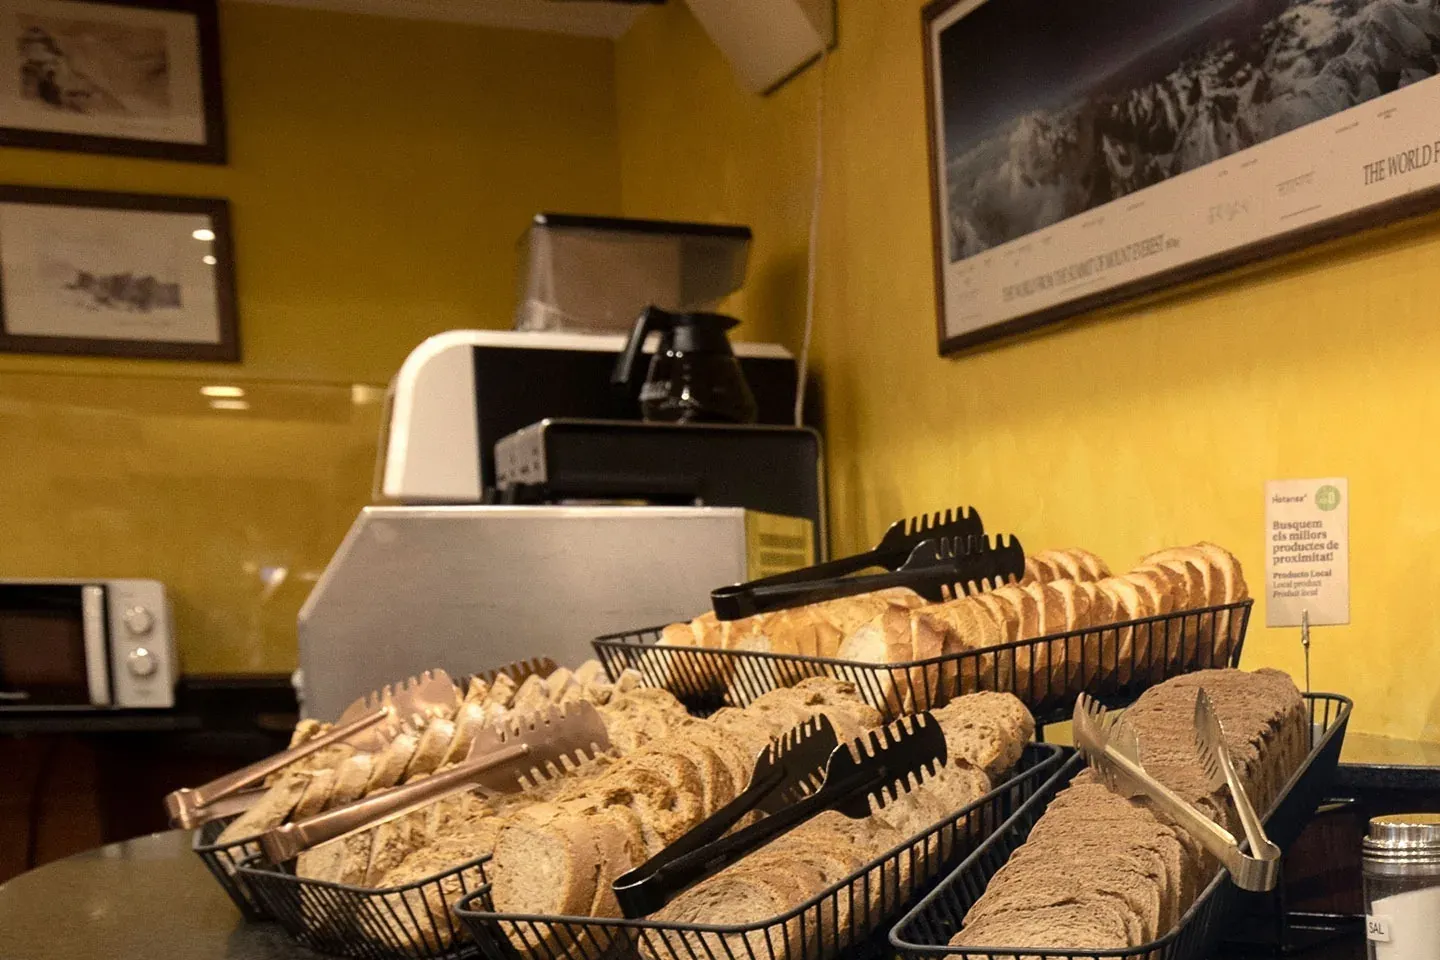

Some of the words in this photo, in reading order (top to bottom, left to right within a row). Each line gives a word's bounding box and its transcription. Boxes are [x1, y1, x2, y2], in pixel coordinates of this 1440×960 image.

[1362, 159, 1385, 186] THE
[1388, 144, 1432, 177] WORLD
[1272, 520, 1322, 531] Busquem
[1272, 531, 1287, 542] els
[1289, 530, 1327, 541] millors
[1272, 541, 1325, 555] productes
[1326, 540, 1339, 550] de
[1272, 551, 1334, 565] proximitat!
[1273, 570, 1310, 579] Producto
[1310, 569, 1332, 578] Local
[1273, 580, 1293, 589] Local
[1293, 579, 1321, 590] product
[1368, 921, 1385, 935] SAL
